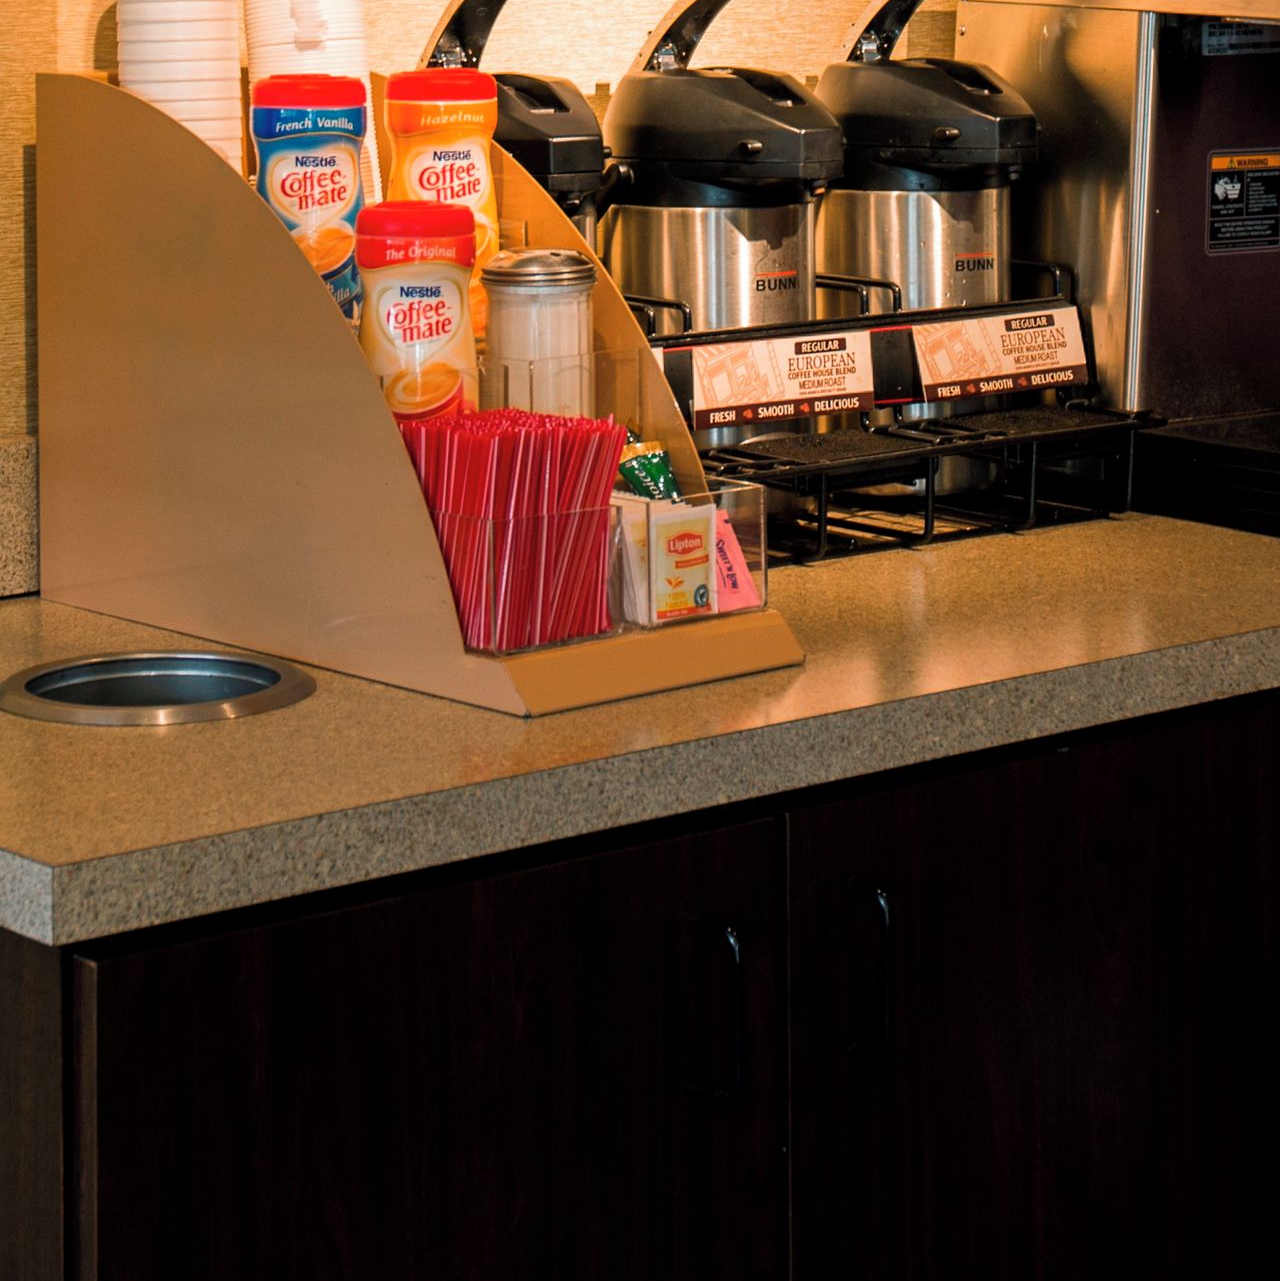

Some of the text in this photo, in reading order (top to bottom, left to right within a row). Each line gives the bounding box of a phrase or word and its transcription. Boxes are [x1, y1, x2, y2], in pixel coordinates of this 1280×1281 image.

[275, 117, 353, 133] French Vanilla
[421, 113, 484, 126] Hazelnut
[295, 156, 336, 167] Nestlé
[433, 150, 472, 162] Nestlé
[1236, 158, 1268, 167] WARNING
[436, 176, 481, 203] mate
[298, 185, 347, 210] mate
[386, 245, 456, 260] The Original
[955, 258, 994, 271] BUNN
[400, 286, 441, 298] Nestlé
[756, 278, 797, 292] BUNN
[402, 317, 453, 343] mate
[1011, 317, 1047, 329] REGULAR
[1000, 327, 1065, 348] EUROPEAN
[801, 340, 839, 353] REGULAR
[1002, 340, 1067, 356] COFFEE HOUSE BLEND
[788, 352, 856, 372] EUROPEAN
[1013, 351, 1058, 365] MEDIUM ROAST
[788, 366, 856, 380] COFFEE HOUSE BLEND
[799, 377, 846, 390] MEDIUM ROAST
[937, 370, 1074, 398] FRESH SMOOTH DELICIOUS
[710, 397, 859, 424] FRESH SMOOTH DELICIOUS
[670, 537, 701, 553] Lipton
